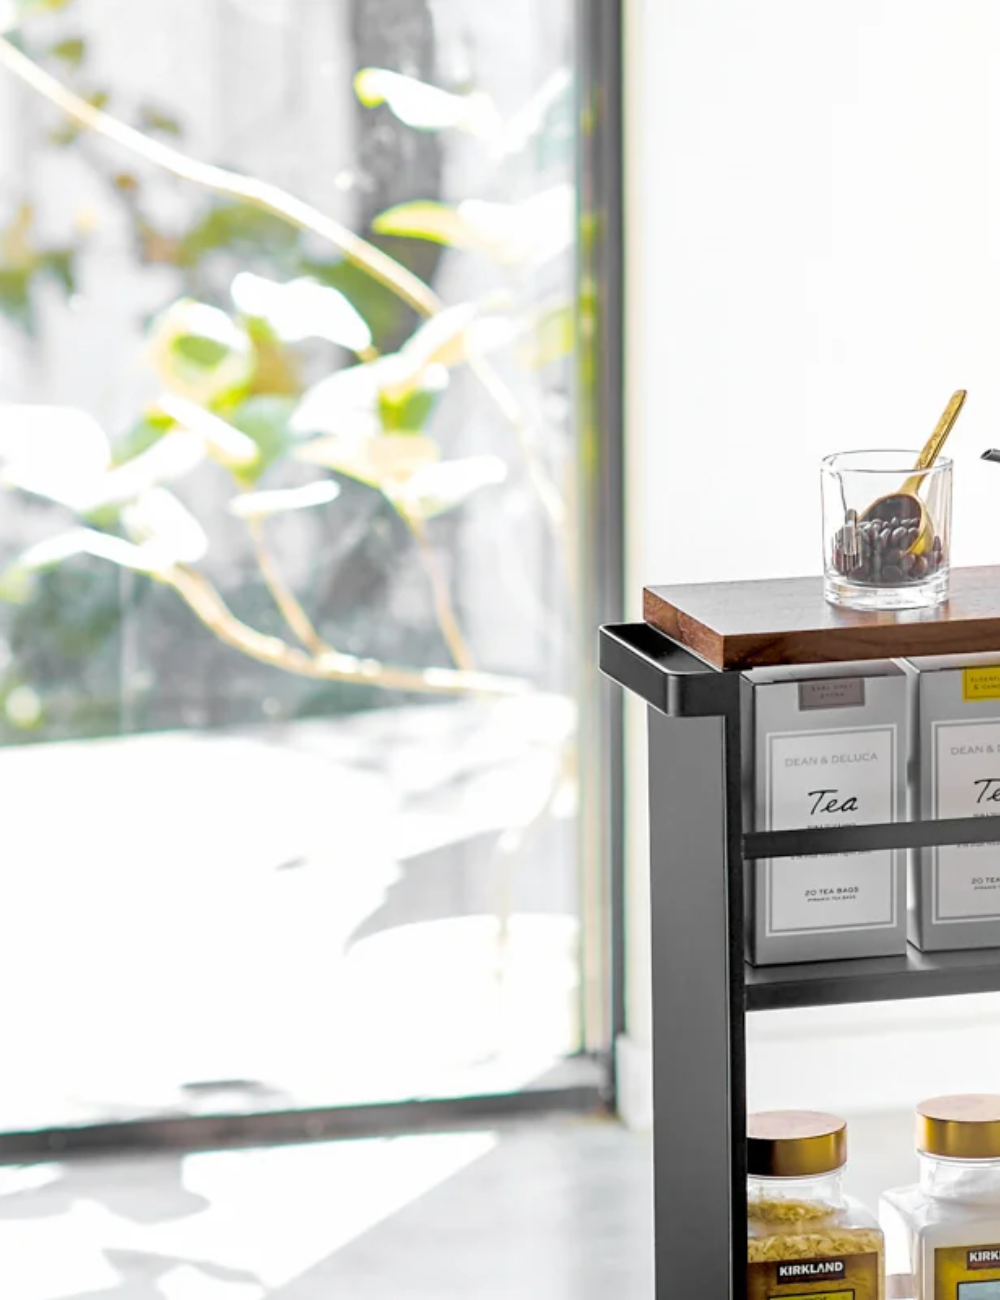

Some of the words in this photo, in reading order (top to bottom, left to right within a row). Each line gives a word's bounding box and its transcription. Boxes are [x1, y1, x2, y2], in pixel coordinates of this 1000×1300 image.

[951, 744, 984, 756] DEAN
[985, 745, 995, 754] &
[784, 756, 818, 768] DEAN
[819, 755, 829, 765] &
[831, 752, 878, 764] DELUCA
[807, 789, 859, 816] Tea
[985, 876, 1000, 884] TEA
[819, 888, 835, 896] TEA
[779, 1261, 844, 1277] KIRKLAND
